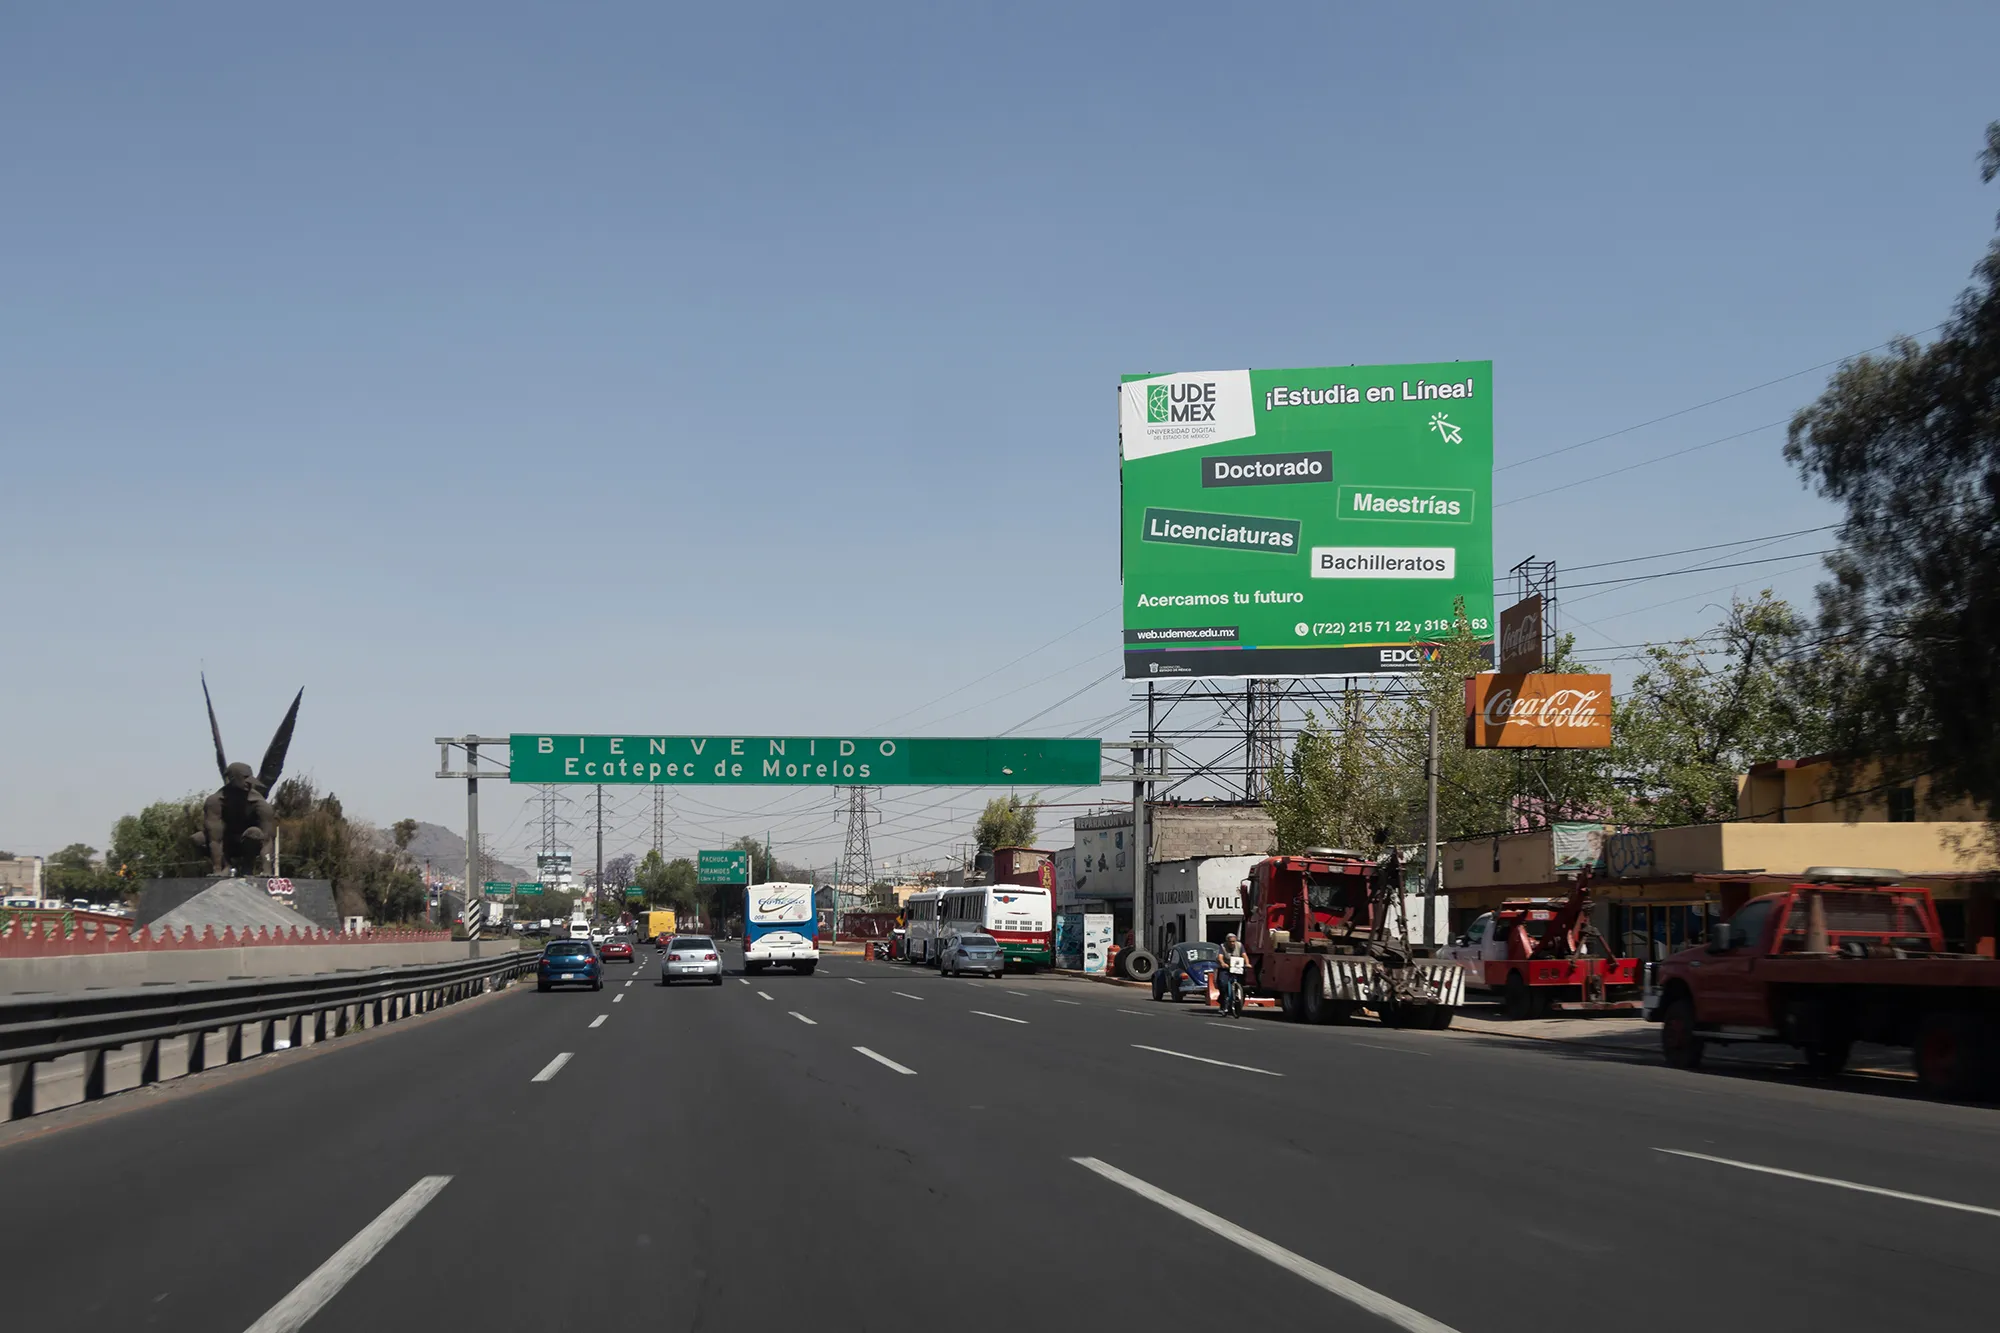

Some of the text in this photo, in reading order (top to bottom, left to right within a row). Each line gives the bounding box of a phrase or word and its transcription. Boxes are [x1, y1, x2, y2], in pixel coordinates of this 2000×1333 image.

[1170, 383, 1216, 403] UDE
[1265, 378, 1474, 411] ¡Estudia en Línea!
[1171, 403, 1216, 422] MEX
[1214, 458, 1323, 479] Doctorado
[1353, 493, 1461, 515] Maestrías
[1150, 518, 1294, 547] Licenciaturas
[1320, 554, 1446, 571] Bachilleratos
[1137, 590, 1304, 607] Acercamos tu futuro
[1137, 628, 1235, 640] web.udemex.edu.mx
[1312, 623, 1345, 637] (722)
[1349, 622, 1372, 633] 215
[1376, 621, 1390, 632] 71
[1395, 621, 1411, 632] 22
[1414, 623, 1421, 634] y
[1471, 618, 1488, 630] 63
[1484, 688, 1603, 727] Coca-Cola
[538, 737, 896, 756] BIENVENIDO
[565, 758, 871, 781] Ecatepec de Morelos
[1206, 897, 1242, 909] VULC
